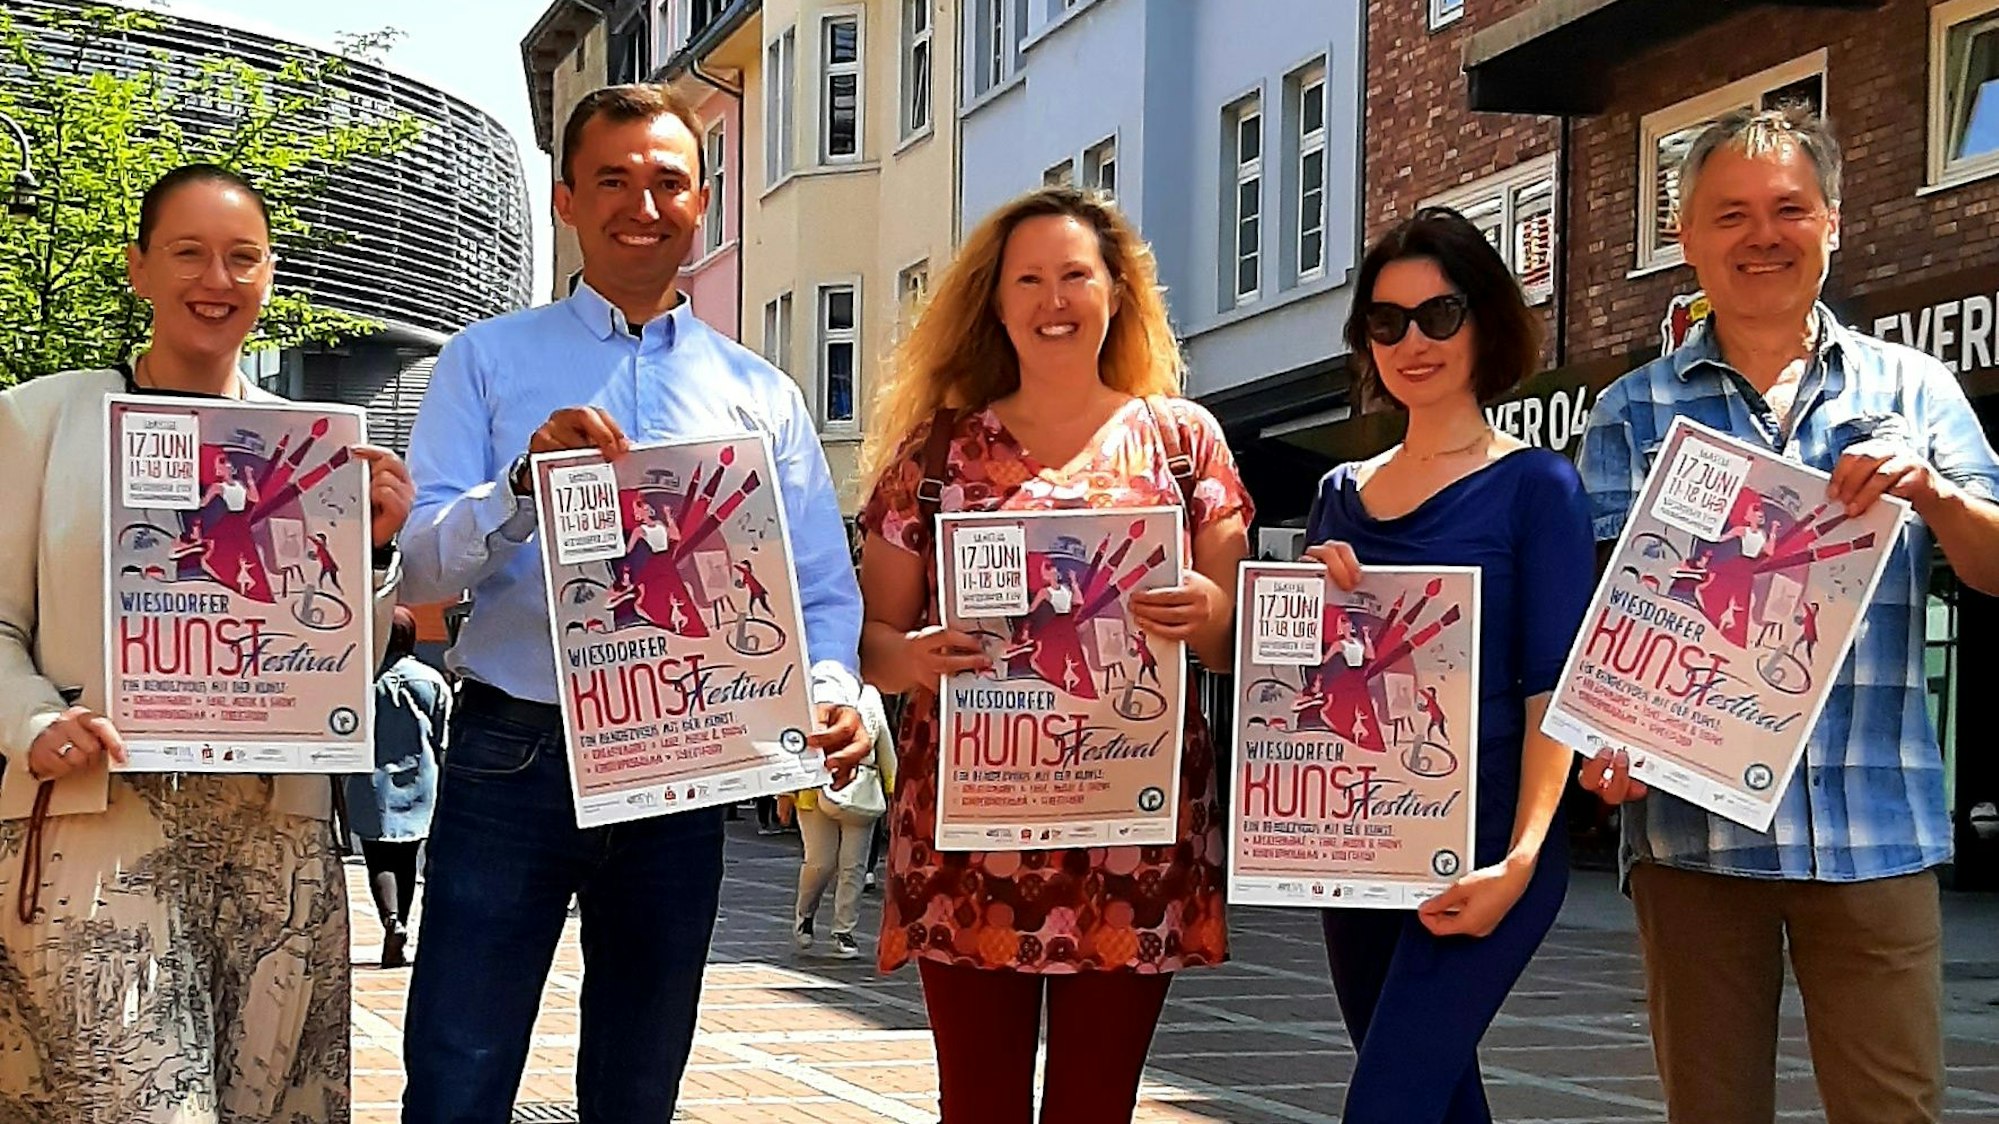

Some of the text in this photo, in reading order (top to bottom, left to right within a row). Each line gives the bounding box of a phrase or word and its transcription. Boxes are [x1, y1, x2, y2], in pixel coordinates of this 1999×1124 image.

[1549, 386, 1588, 451] 04
[121, 592, 229, 613] WIESDORFER
[1609, 586, 1705, 643] WIESDORFER
[120, 616, 357, 679] KUNST Festival
[567, 636, 669, 668] WIESDORFER
[1585, 606, 1731, 707] KUNST
[1686, 666, 1802, 735] Festival
[571, 653, 794, 731] KUNST Festival
[955, 689, 1056, 710] WIESDORFER
[953, 712, 1169, 769] KUNST Festival
[1245, 740, 1344, 761] WIESDORFER
[1244, 761, 1461, 824] KUNST Festival
